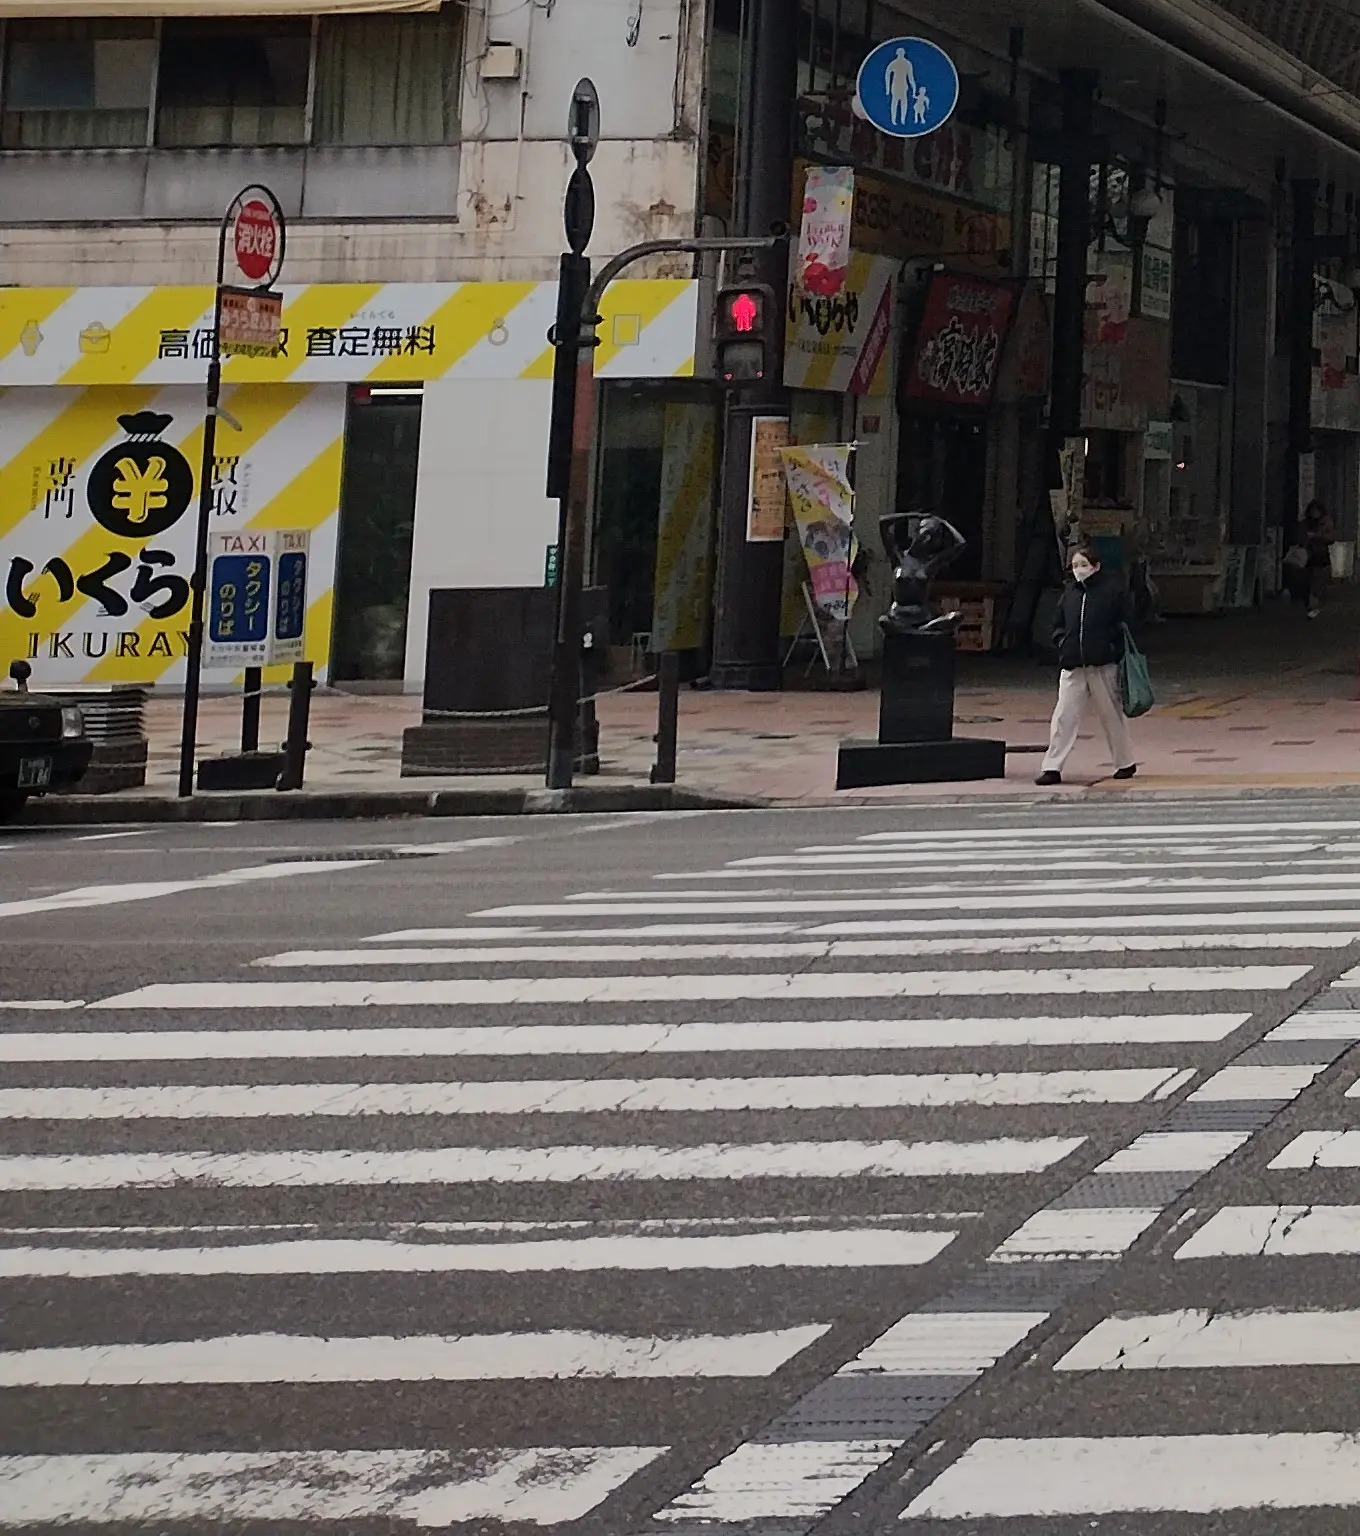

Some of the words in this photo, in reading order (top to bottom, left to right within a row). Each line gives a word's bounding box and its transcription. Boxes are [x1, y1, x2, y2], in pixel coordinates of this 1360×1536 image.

[237, 223, 274, 258] 消火栓
[305, 324, 437, 358] 査定無料
[44, 456, 76, 519] 専門
[210, 455, 240, 516] 買取
[220, 535, 267, 552] TAXI
[282, 533, 306, 550] TAXI
[217, 583, 237, 637] のりば
[244, 560, 263, 632] タクシー
